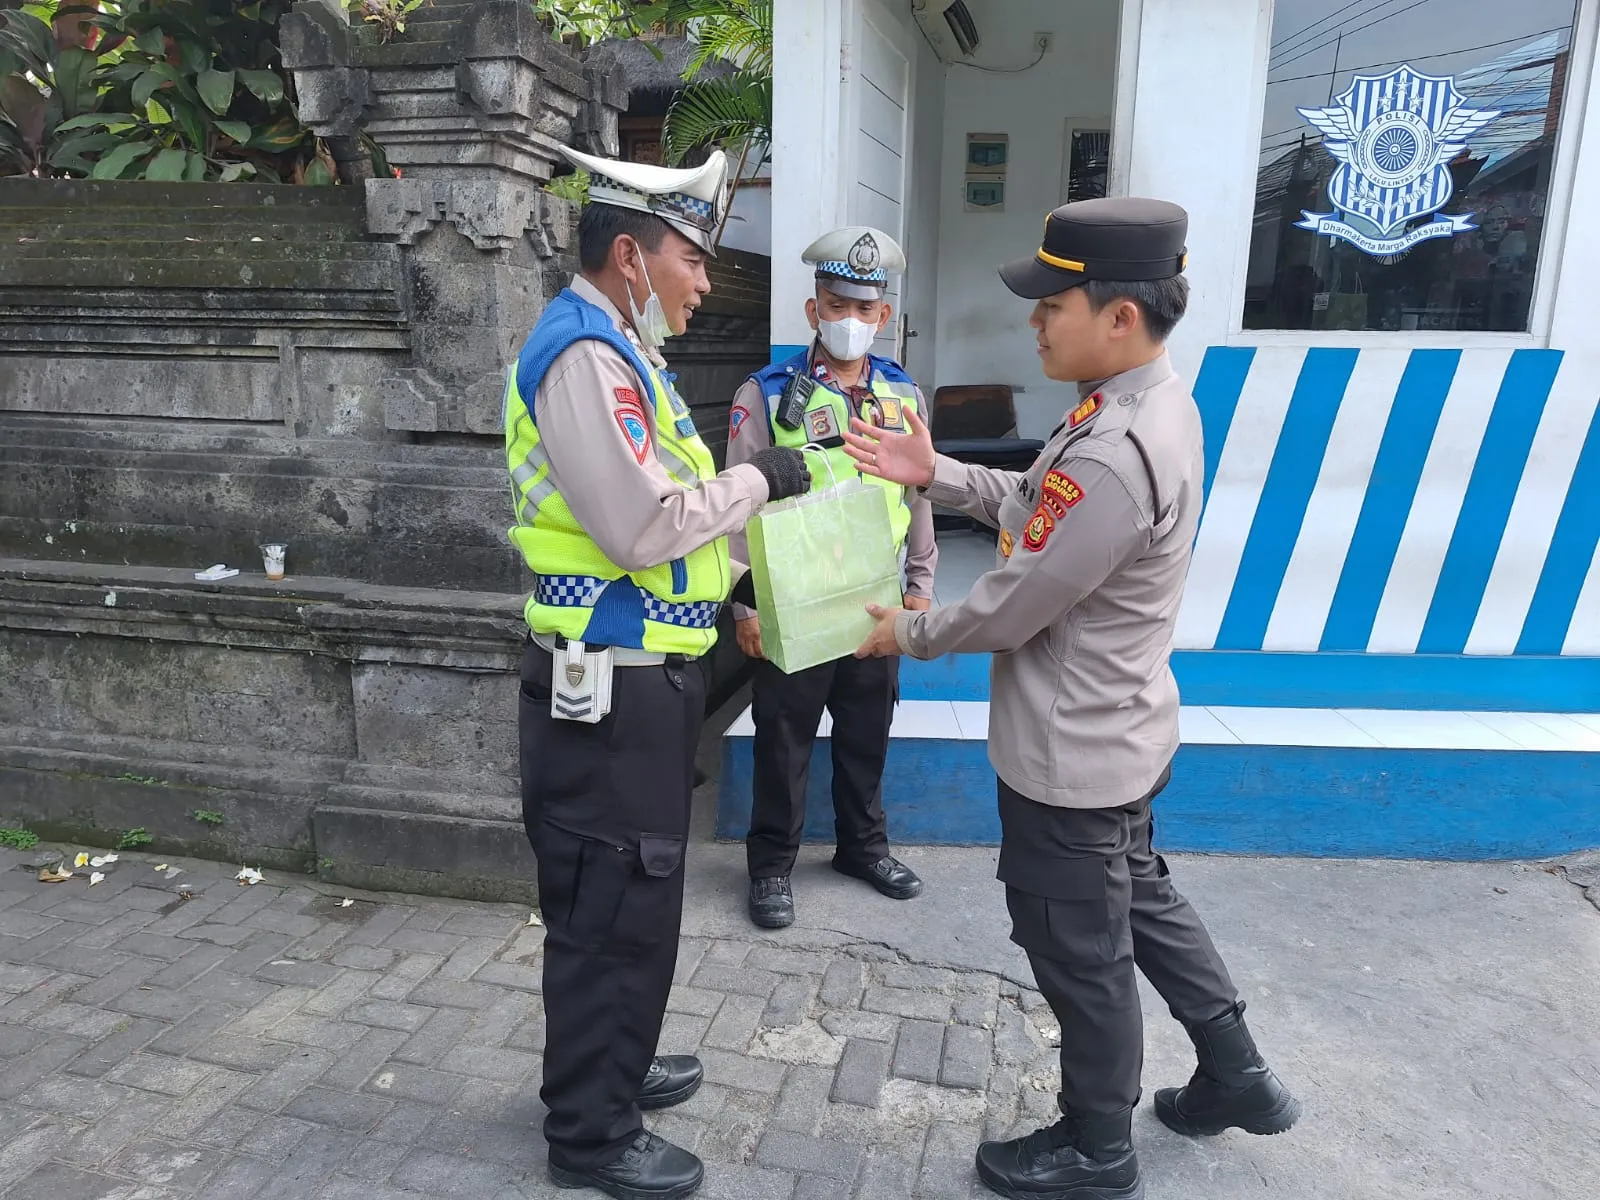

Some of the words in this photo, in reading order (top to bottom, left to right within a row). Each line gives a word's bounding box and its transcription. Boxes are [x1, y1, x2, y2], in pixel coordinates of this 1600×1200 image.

[1376, 111, 1421, 125] POLISI
[1369, 173, 1387, 186] LALU
[1387, 174, 1414, 187] LINTAS
[1322, 222, 1376, 251] Dharmakerta
[1377, 241, 1405, 252] Marga
[1406, 226, 1452, 244] Raksyaka
[1047, 472, 1080, 498] POLRES
